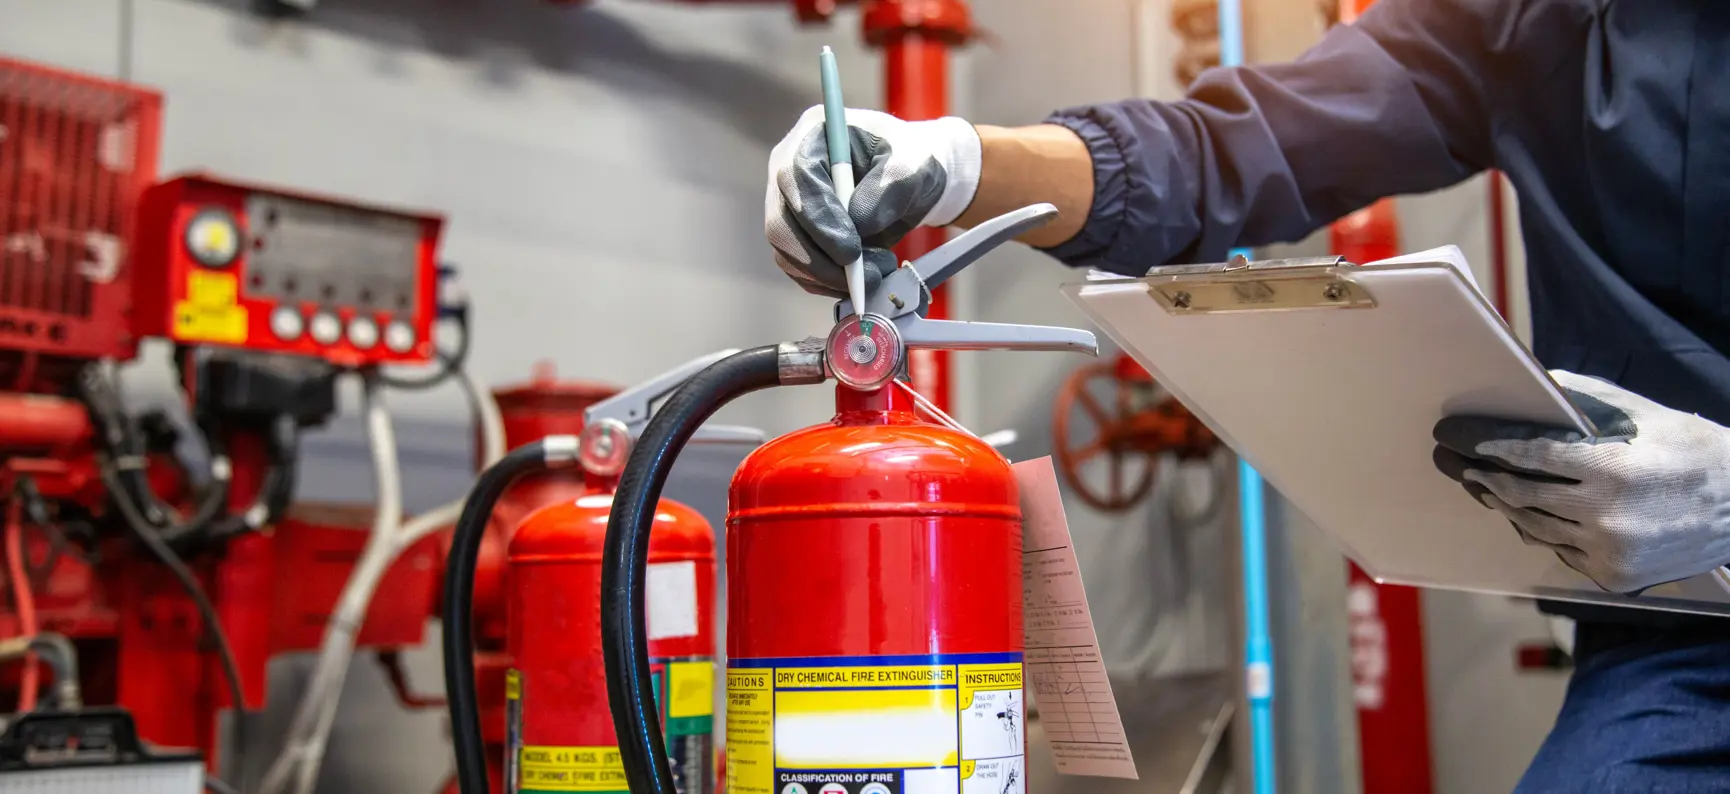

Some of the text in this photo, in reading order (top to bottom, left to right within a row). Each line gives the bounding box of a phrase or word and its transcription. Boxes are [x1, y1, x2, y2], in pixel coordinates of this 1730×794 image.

[777, 669, 953, 683] DRY CHEMICAL FIRE EXTINGUISHER
[965, 672, 1021, 685] INSTRUCTIONS
[780, 772, 894, 783] CLASSIFICATION OF FIRE
